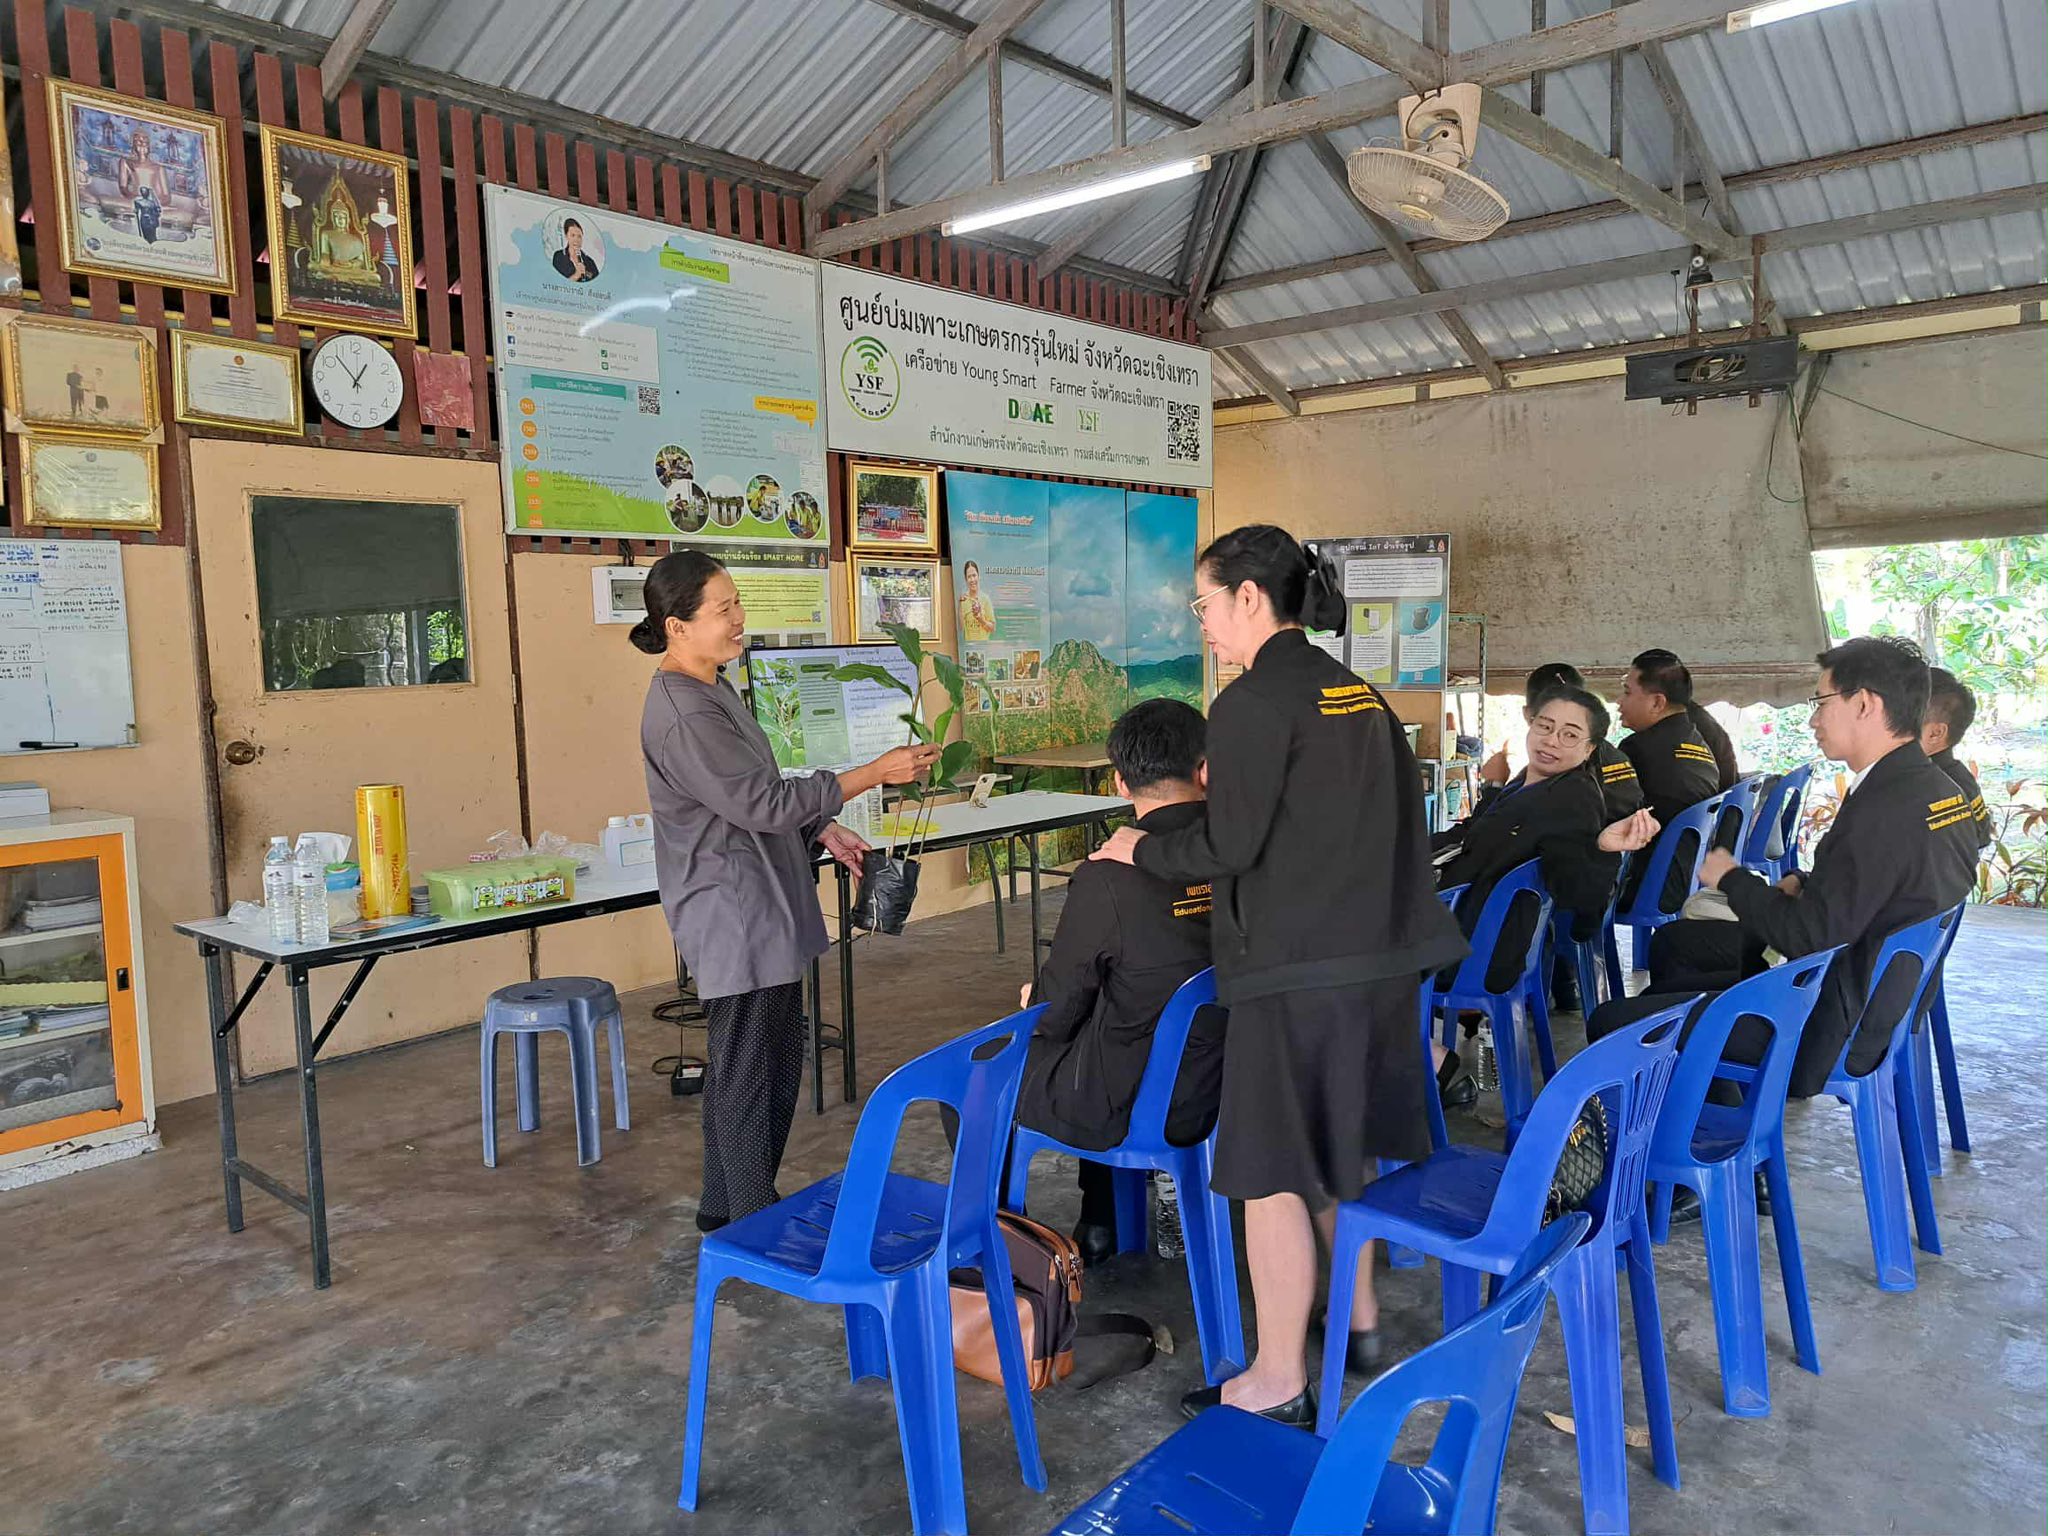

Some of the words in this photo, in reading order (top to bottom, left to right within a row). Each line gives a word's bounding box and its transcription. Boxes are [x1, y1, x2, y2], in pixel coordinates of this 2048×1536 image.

[839, 291, 1079, 367] ศูนย์บ่มเพาะเกษตรกรรุ่นใหม่
[1084, 340, 1199, 387] จังหวัดฉะเชิงเทรา
[335, 343, 345, 357] 11
[350, 341, 361, 355] 12
[322, 355, 337, 369] 10
[381, 363, 390, 376] 2
[315, 371, 325, 383] 9
[855, 373, 884, 391] YSF
[905, 348, 957, 375] เครือข่าย
[962, 360, 999, 387] Young
[1002, 369, 1037, 390] Smart
[1050, 377, 1088, 397] Farmer
[1091, 380, 1165, 410] จังหวัดฉะเชิงเทรา
[388, 381, 397, 394] 3
[322, 389, 331, 402] 8
[336, 403, 345, 416] 7
[380, 397, 391, 409] 4
[352, 410, 361, 423] 6
[369, 408, 378, 421] 5
[763, 553, 784, 561] SMART
[786, 554, 804, 562] HOME
